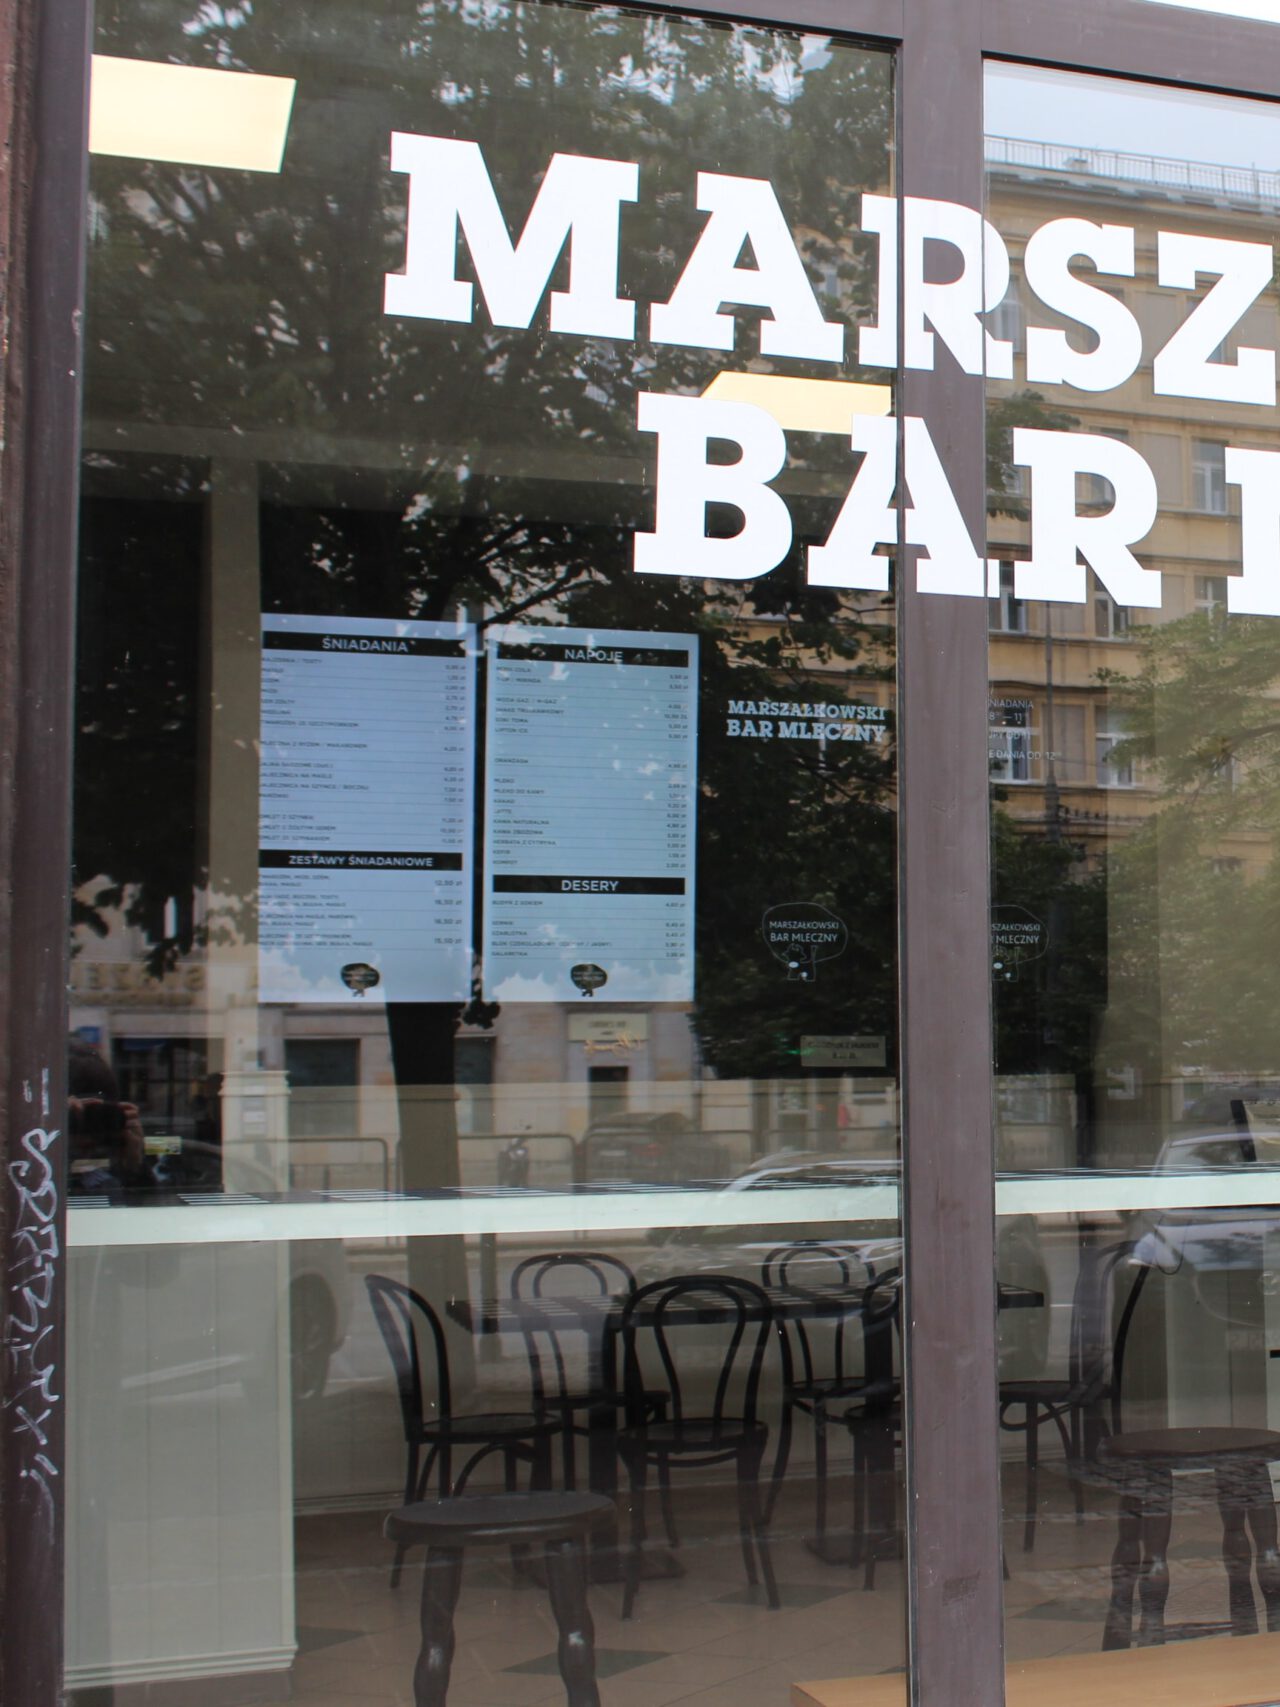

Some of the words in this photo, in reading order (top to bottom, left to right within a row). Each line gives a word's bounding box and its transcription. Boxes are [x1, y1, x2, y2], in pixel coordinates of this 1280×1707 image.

[633, 391, 1162, 608] BAR
[322, 635, 408, 652] ŚNIADANIA
[564, 648, 623, 662] NAPOJE
[727, 700, 886, 720] MARSZAŁKOWSKI
[988, 698, 1034, 709] NIADANIA
[726, 719, 773, 738] BAR
[778, 721, 886, 742] MLECZNY
[288, 854, 345, 866] ZESTAWY
[348, 853, 433, 867] ŚNIADANIOWE
[561, 879, 619, 892] DESERY
[769, 920, 839, 930] MARSZAŁKOWSKI
[991, 923, 1041, 932] SZAŁKOWSKI
[770, 933, 789, 942] BAR
[791, 933, 838, 943] MLECZNY
[995, 935, 1040, 945] MLECZNY
